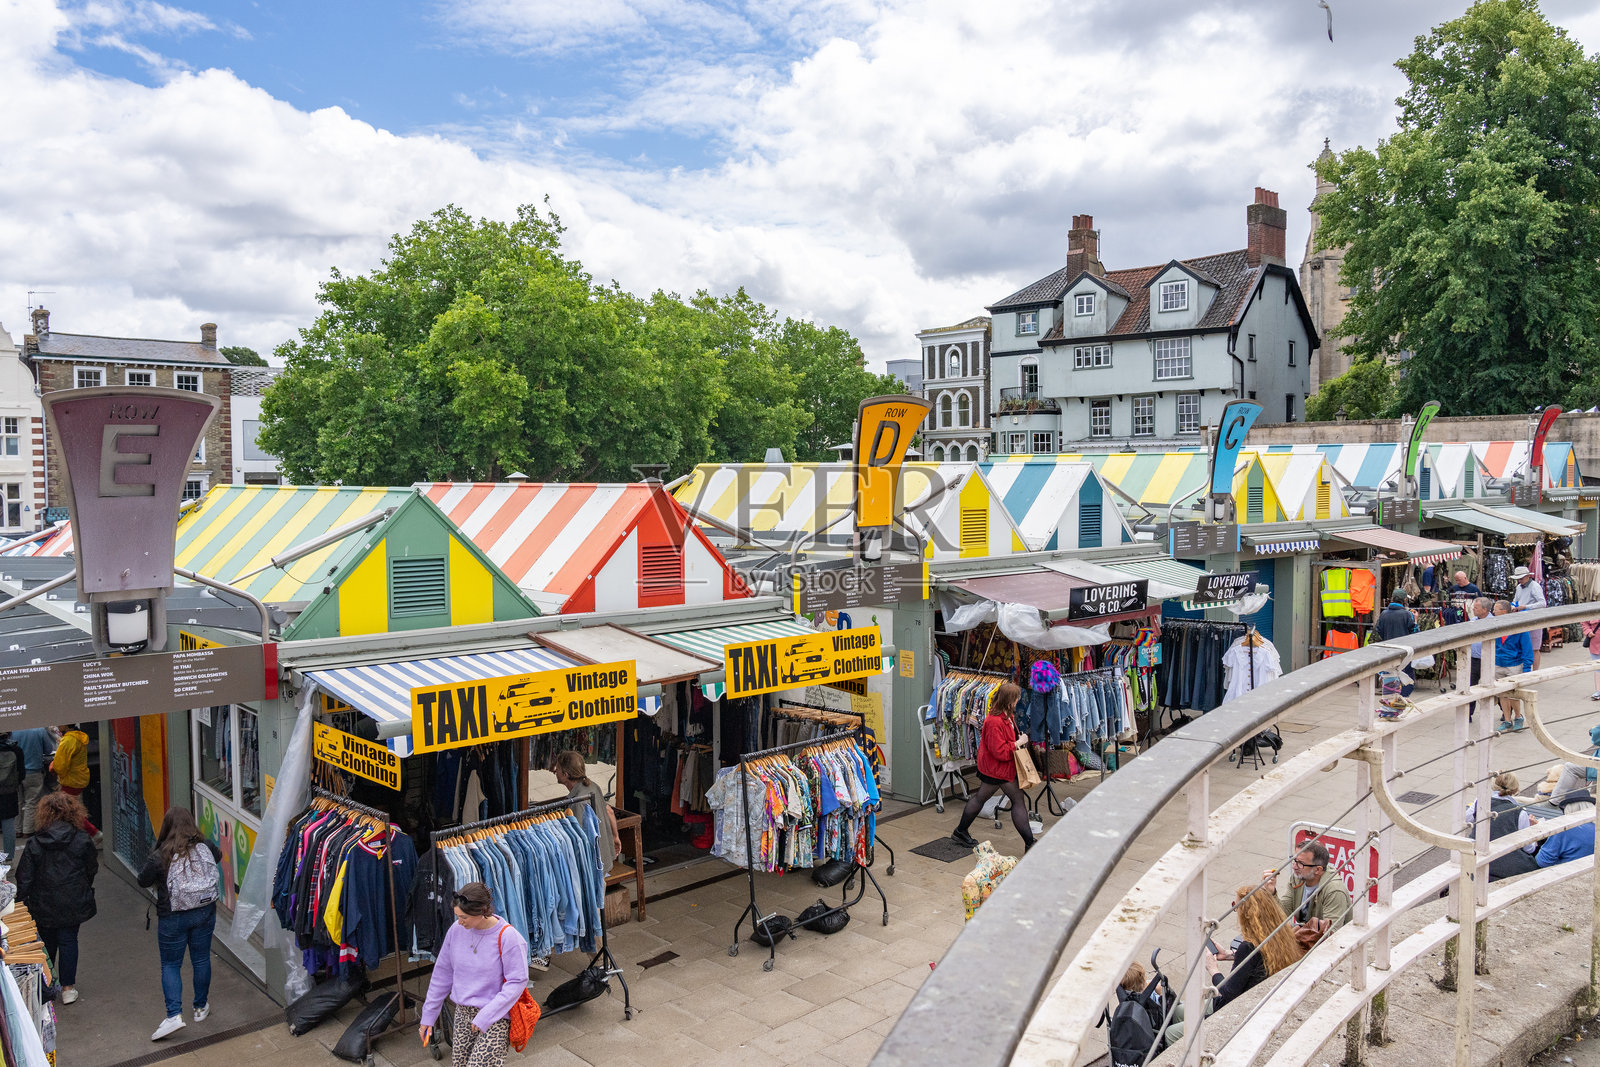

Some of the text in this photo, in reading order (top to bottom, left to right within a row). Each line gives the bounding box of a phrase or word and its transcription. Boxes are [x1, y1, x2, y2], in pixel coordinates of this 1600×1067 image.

[110, 404, 160, 419] ROW
[884, 408, 908, 418] ROW
[868, 420, 900, 468] D
[1224, 416, 1246, 450] C
[99, 424, 160, 498] E
[1084, 583, 1138, 602] LOVERING
[1208, 574, 1250, 589] LOVERING
[1217, 588, 1235, 600] & CO.
[1099, 600, 1121, 614] & CO.
[832, 634, 876, 652] Vintage
[728, 644, 778, 693] TAXI
[834, 656, 881, 675] Clothing
[566, 670, 628, 692] Vintage
[416, 685, 490, 746] TAXI
[568, 694, 635, 720] Clothing
[342, 734, 396, 768] Vintage
[341, 750, 398, 788] Clothing
